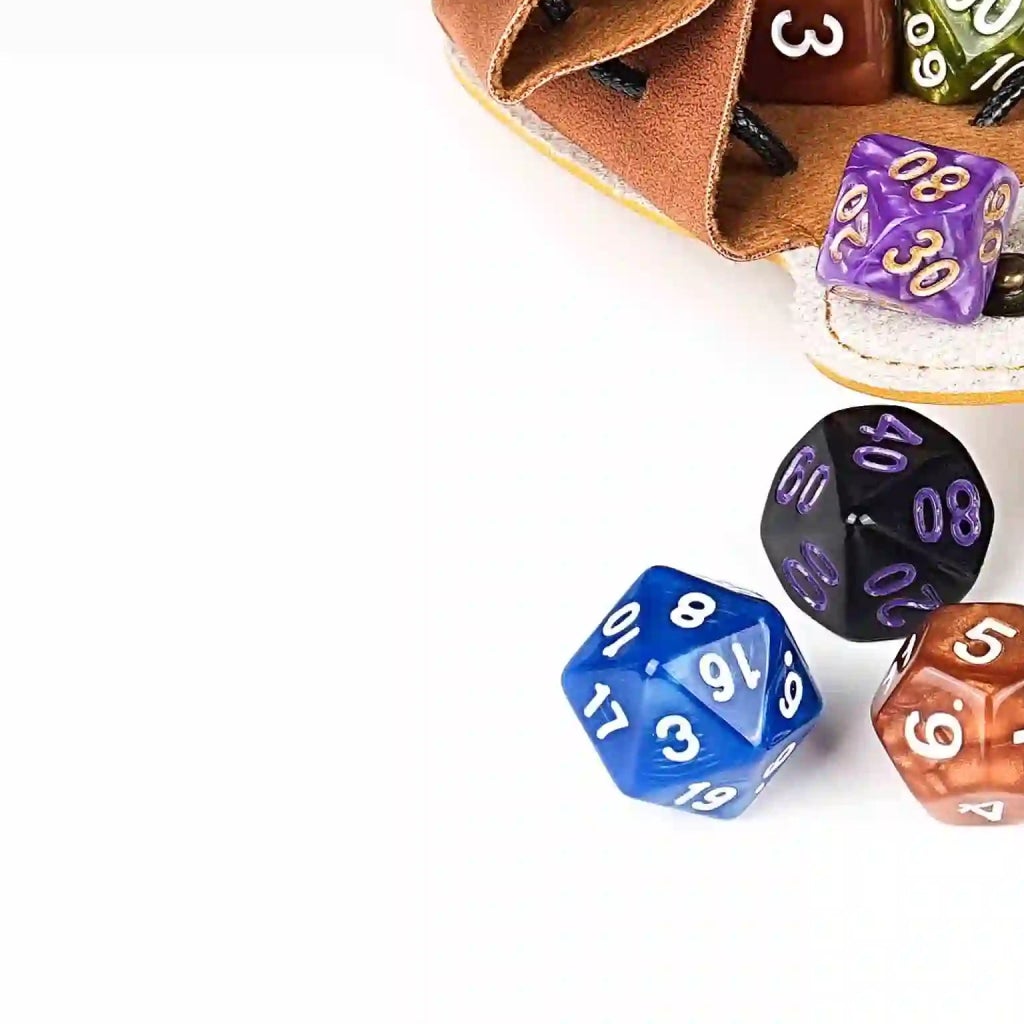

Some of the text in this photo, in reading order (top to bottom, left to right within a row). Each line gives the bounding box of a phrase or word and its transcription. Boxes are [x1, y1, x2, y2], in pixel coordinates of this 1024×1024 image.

[771, 9, 844, 57] 3
[888, 150, 970, 202] 80
[829, 184, 869, 264] 20
[882, 228, 960, 297] 30
[853, 413, 923, 473] 40
[913, 478, 982, 547] 80
[601, 601, 641, 657] 10
[669, 591, 717, 629] 8
[952, 616, 1020, 665] 5
[698, 642, 762, 703] 16
[583, 682, 630, 740] 17
[655, 714, 701, 763] 3
[674, 781, 738, 811] 19
[956, 800, 1005, 822] 4
